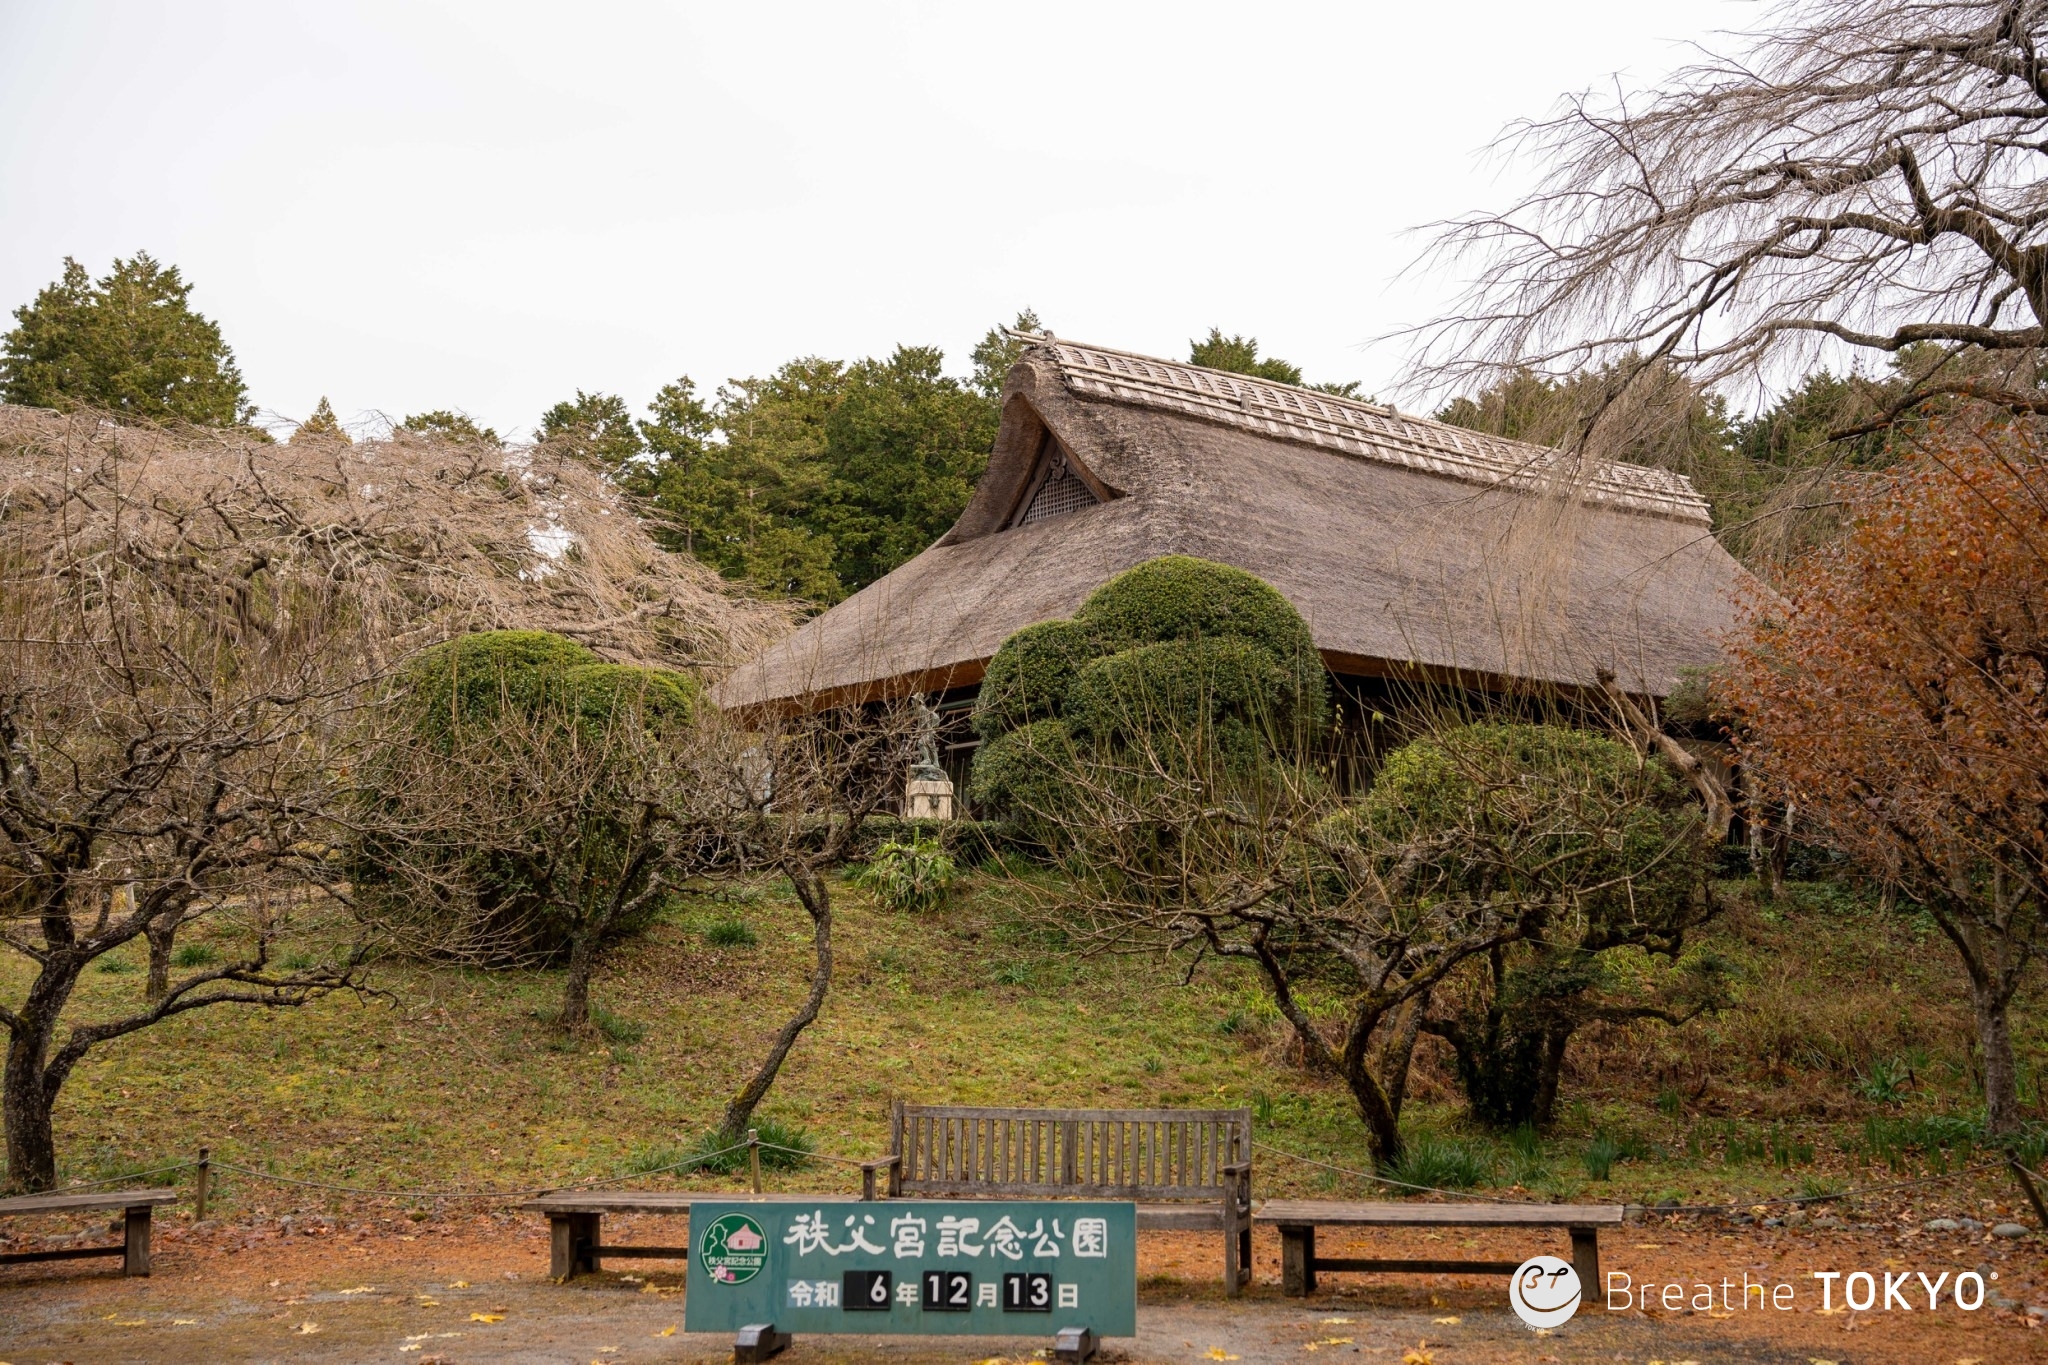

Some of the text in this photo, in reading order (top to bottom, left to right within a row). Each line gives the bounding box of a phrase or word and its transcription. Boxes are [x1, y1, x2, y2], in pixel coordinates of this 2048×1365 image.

[783, 1210, 1107, 1260] 秩父宮記念公園
